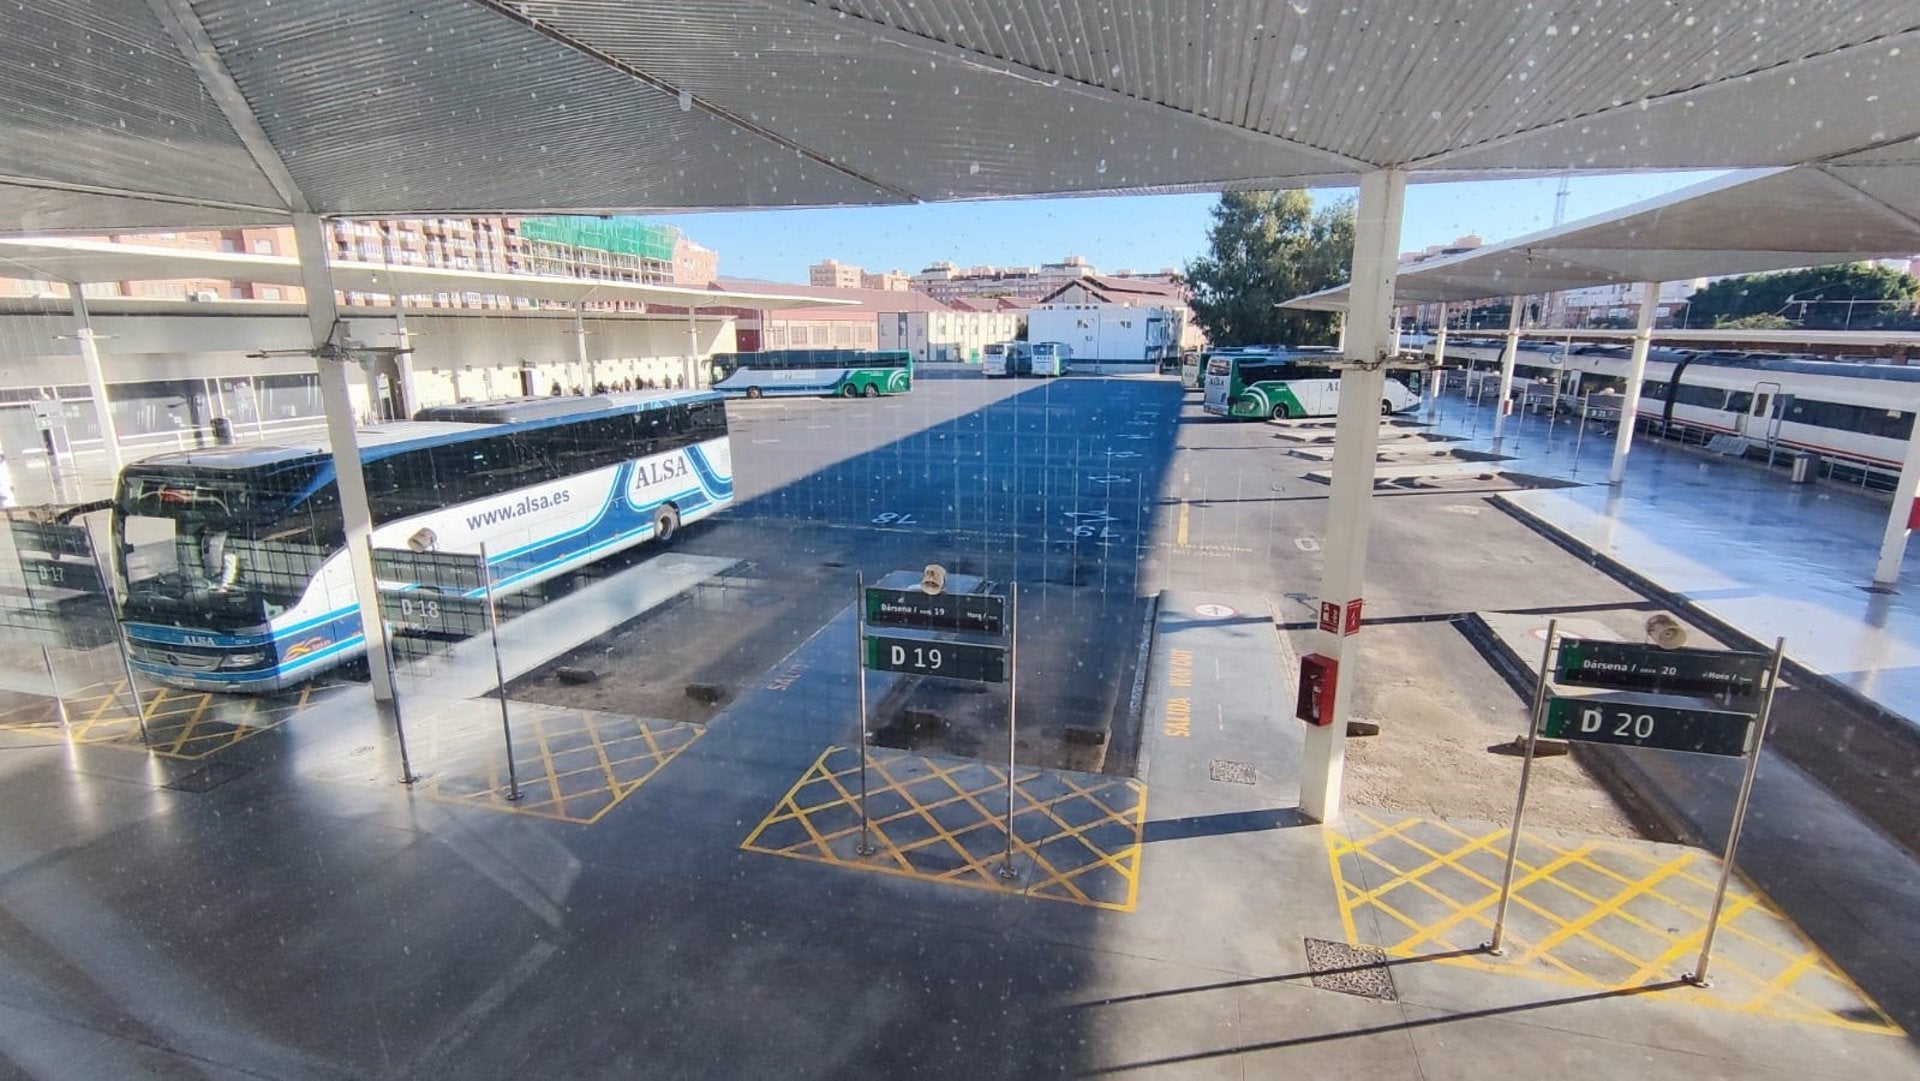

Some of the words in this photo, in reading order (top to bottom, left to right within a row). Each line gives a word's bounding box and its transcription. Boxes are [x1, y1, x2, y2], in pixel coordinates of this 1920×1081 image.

[635, 456, 688, 489] ALSA
[467, 490, 570, 530] www.alsa.es
[38, 565, 48, 580] D
[50, 566, 64, 582] 17
[401, 599, 413, 615] D
[418, 600, 439, 618] 18
[934, 608, 945, 616] 19
[184, 635, 215, 646] ALSA
[891, 645, 906, 665] D
[914, 648, 942, 669] 19
[1583, 659, 1628, 672] Dársena
[1662, 666, 1677, 676] 20
[1163, 698, 1191, 737] SALIDA
[1580, 709, 1602, 733] D
[1613, 713, 1654, 738] 20
